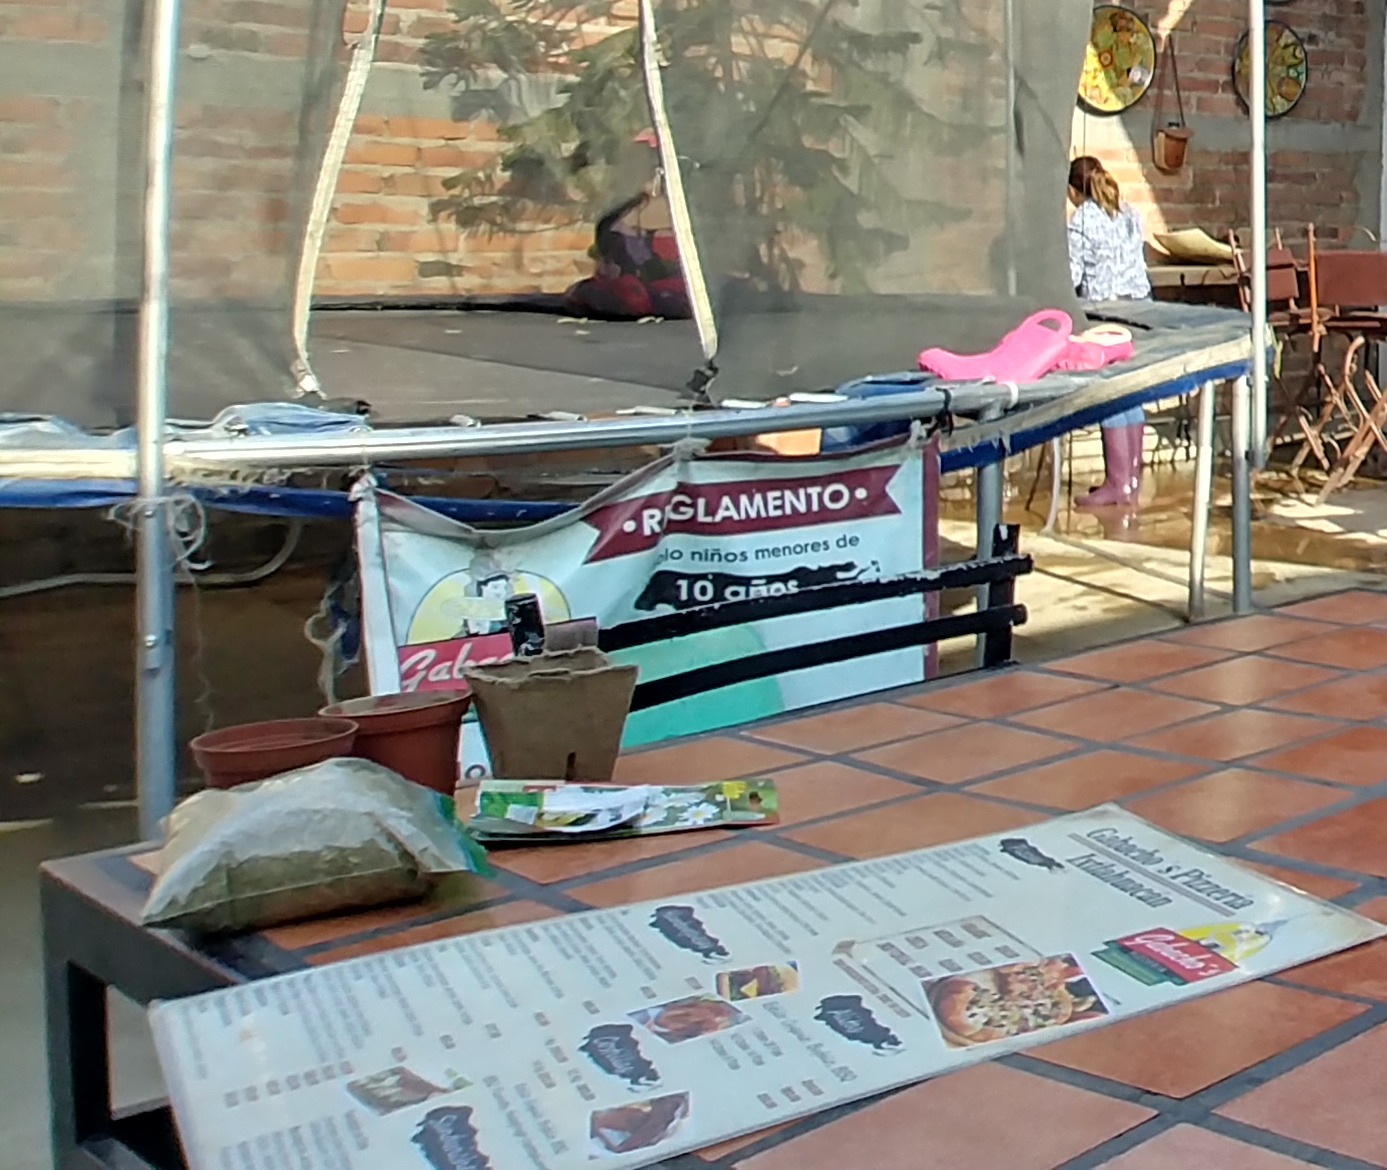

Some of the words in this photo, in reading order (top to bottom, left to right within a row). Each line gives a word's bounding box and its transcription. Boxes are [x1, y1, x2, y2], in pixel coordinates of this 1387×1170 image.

[642, 484, 850, 536] RGLAMENTO
[690, 547, 748, 564] niños
[754, 539, 830, 562] menores
[835, 533, 860, 550] de
[675, 578, 715, 602] 10
[723, 578, 800, 601] años
